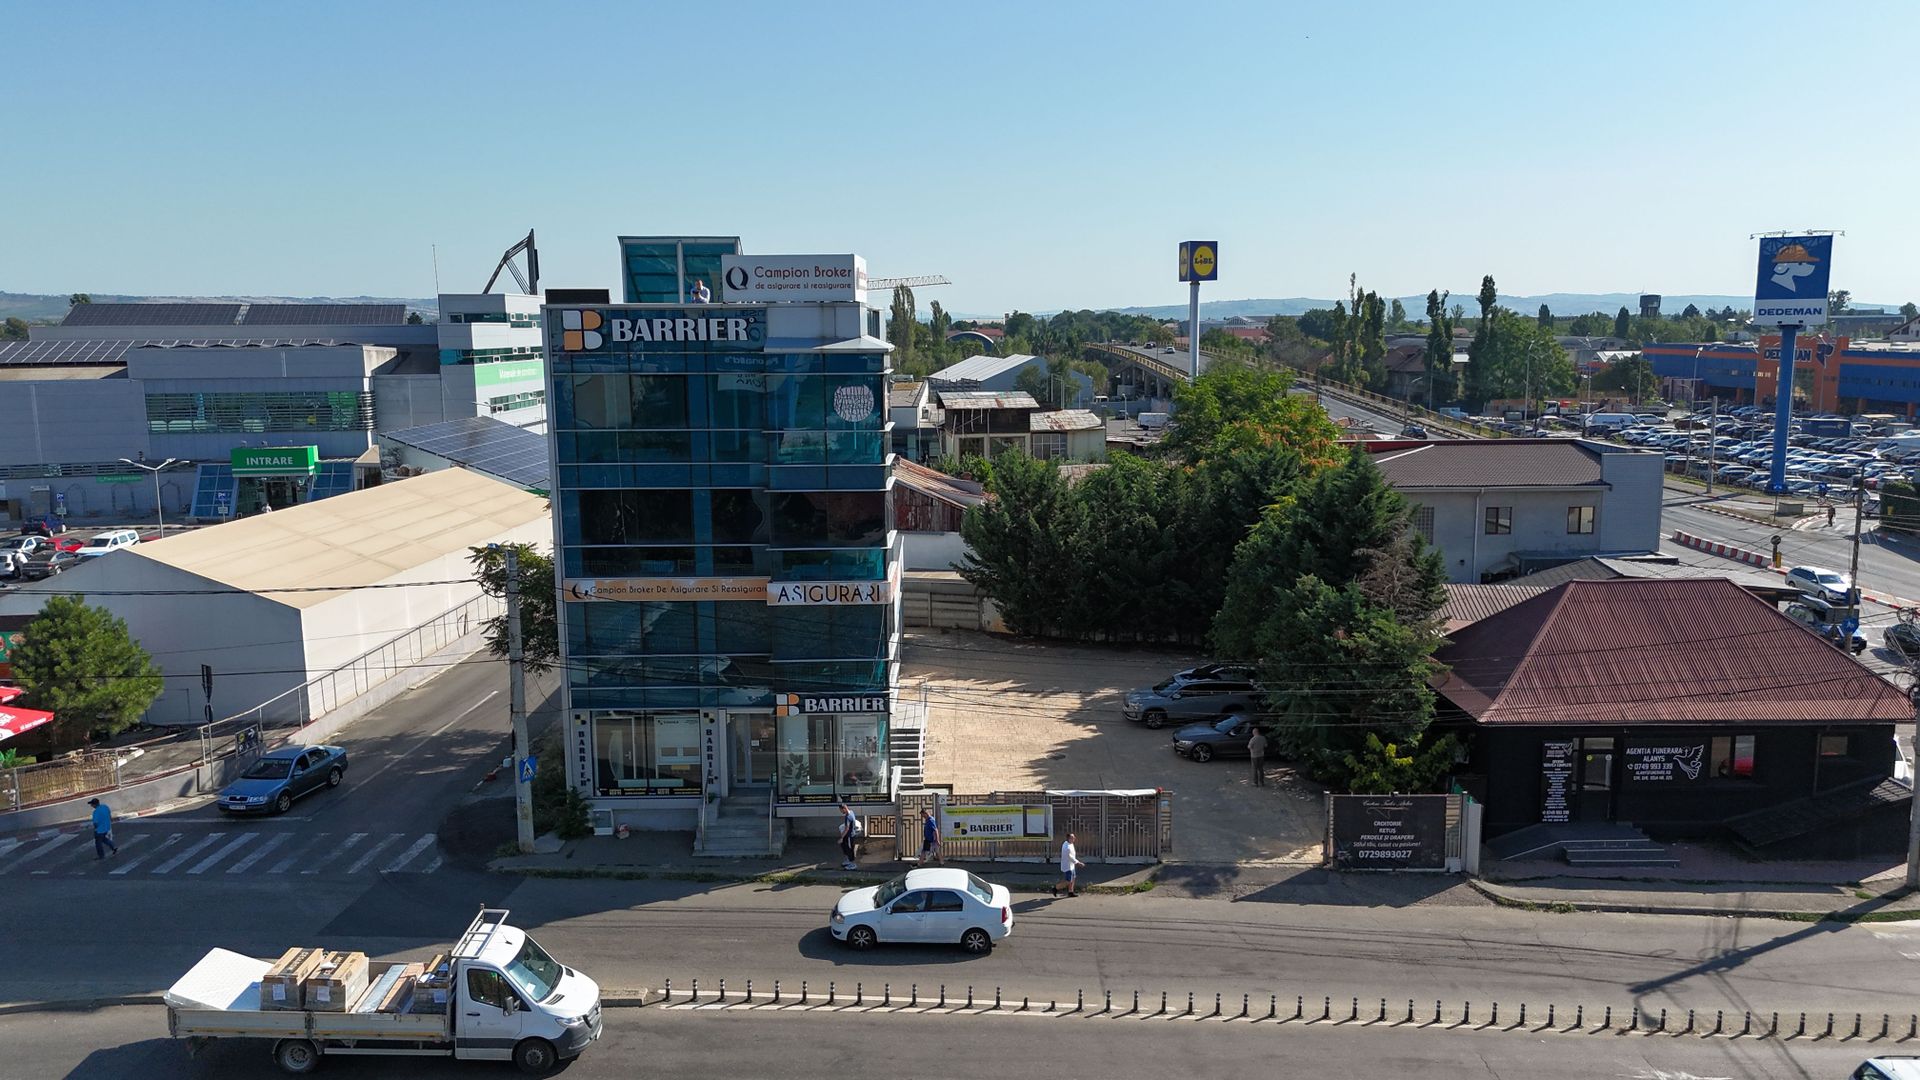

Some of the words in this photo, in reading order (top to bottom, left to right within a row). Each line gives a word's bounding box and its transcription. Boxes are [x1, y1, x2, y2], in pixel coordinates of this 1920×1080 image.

[754, 266, 809, 279] Campion
[814, 266, 852, 278] Broker
[811, 282, 851, 290] reasigurare
[1758, 308, 1822, 316] DEDEMAN
[611, 318, 748, 341] BARRIER
[246, 457, 293, 465] INTRARE
[590, 586, 626, 595] Campion
[629, 585, 654, 593] Broker
[656, 585, 667, 593] De
[670, 585, 709, 594] Asigurare
[711, 585, 718, 593] Si
[778, 585, 880, 603] ASIGURARI
[804, 698, 885, 712] BARRIER
[970, 824, 1013, 832] BARRIER
[1359, 850, 1412, 858] 0729893027
